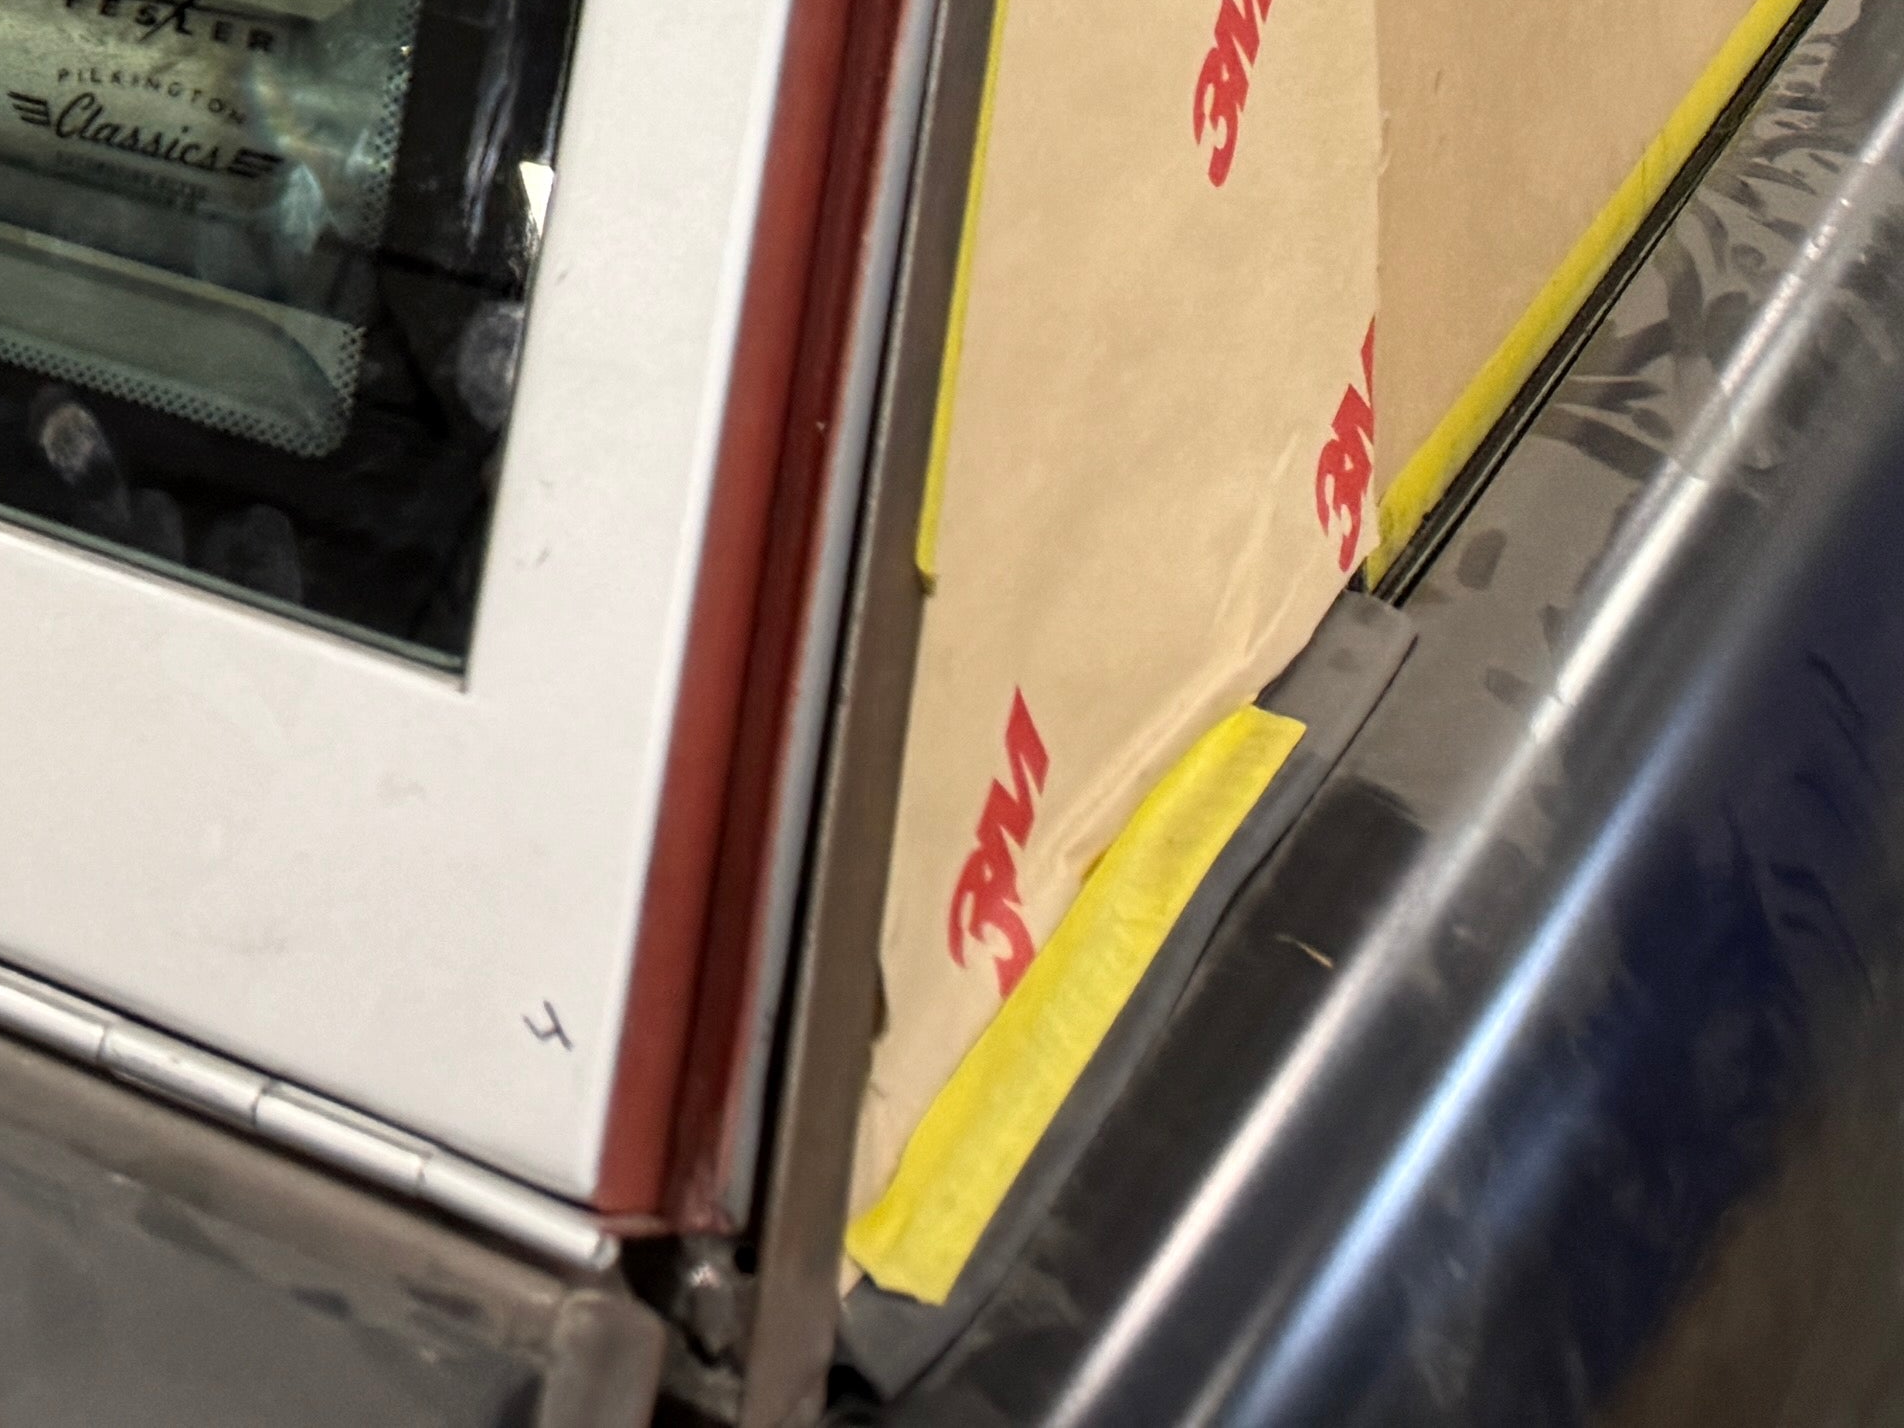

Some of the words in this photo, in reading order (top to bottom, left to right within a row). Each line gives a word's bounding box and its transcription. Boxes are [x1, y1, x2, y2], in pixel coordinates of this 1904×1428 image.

[55, 92, 220, 172] Classics
[56, 66, 247, 127] PILKINGTON
[948, 684, 1050, 1001] 3M
